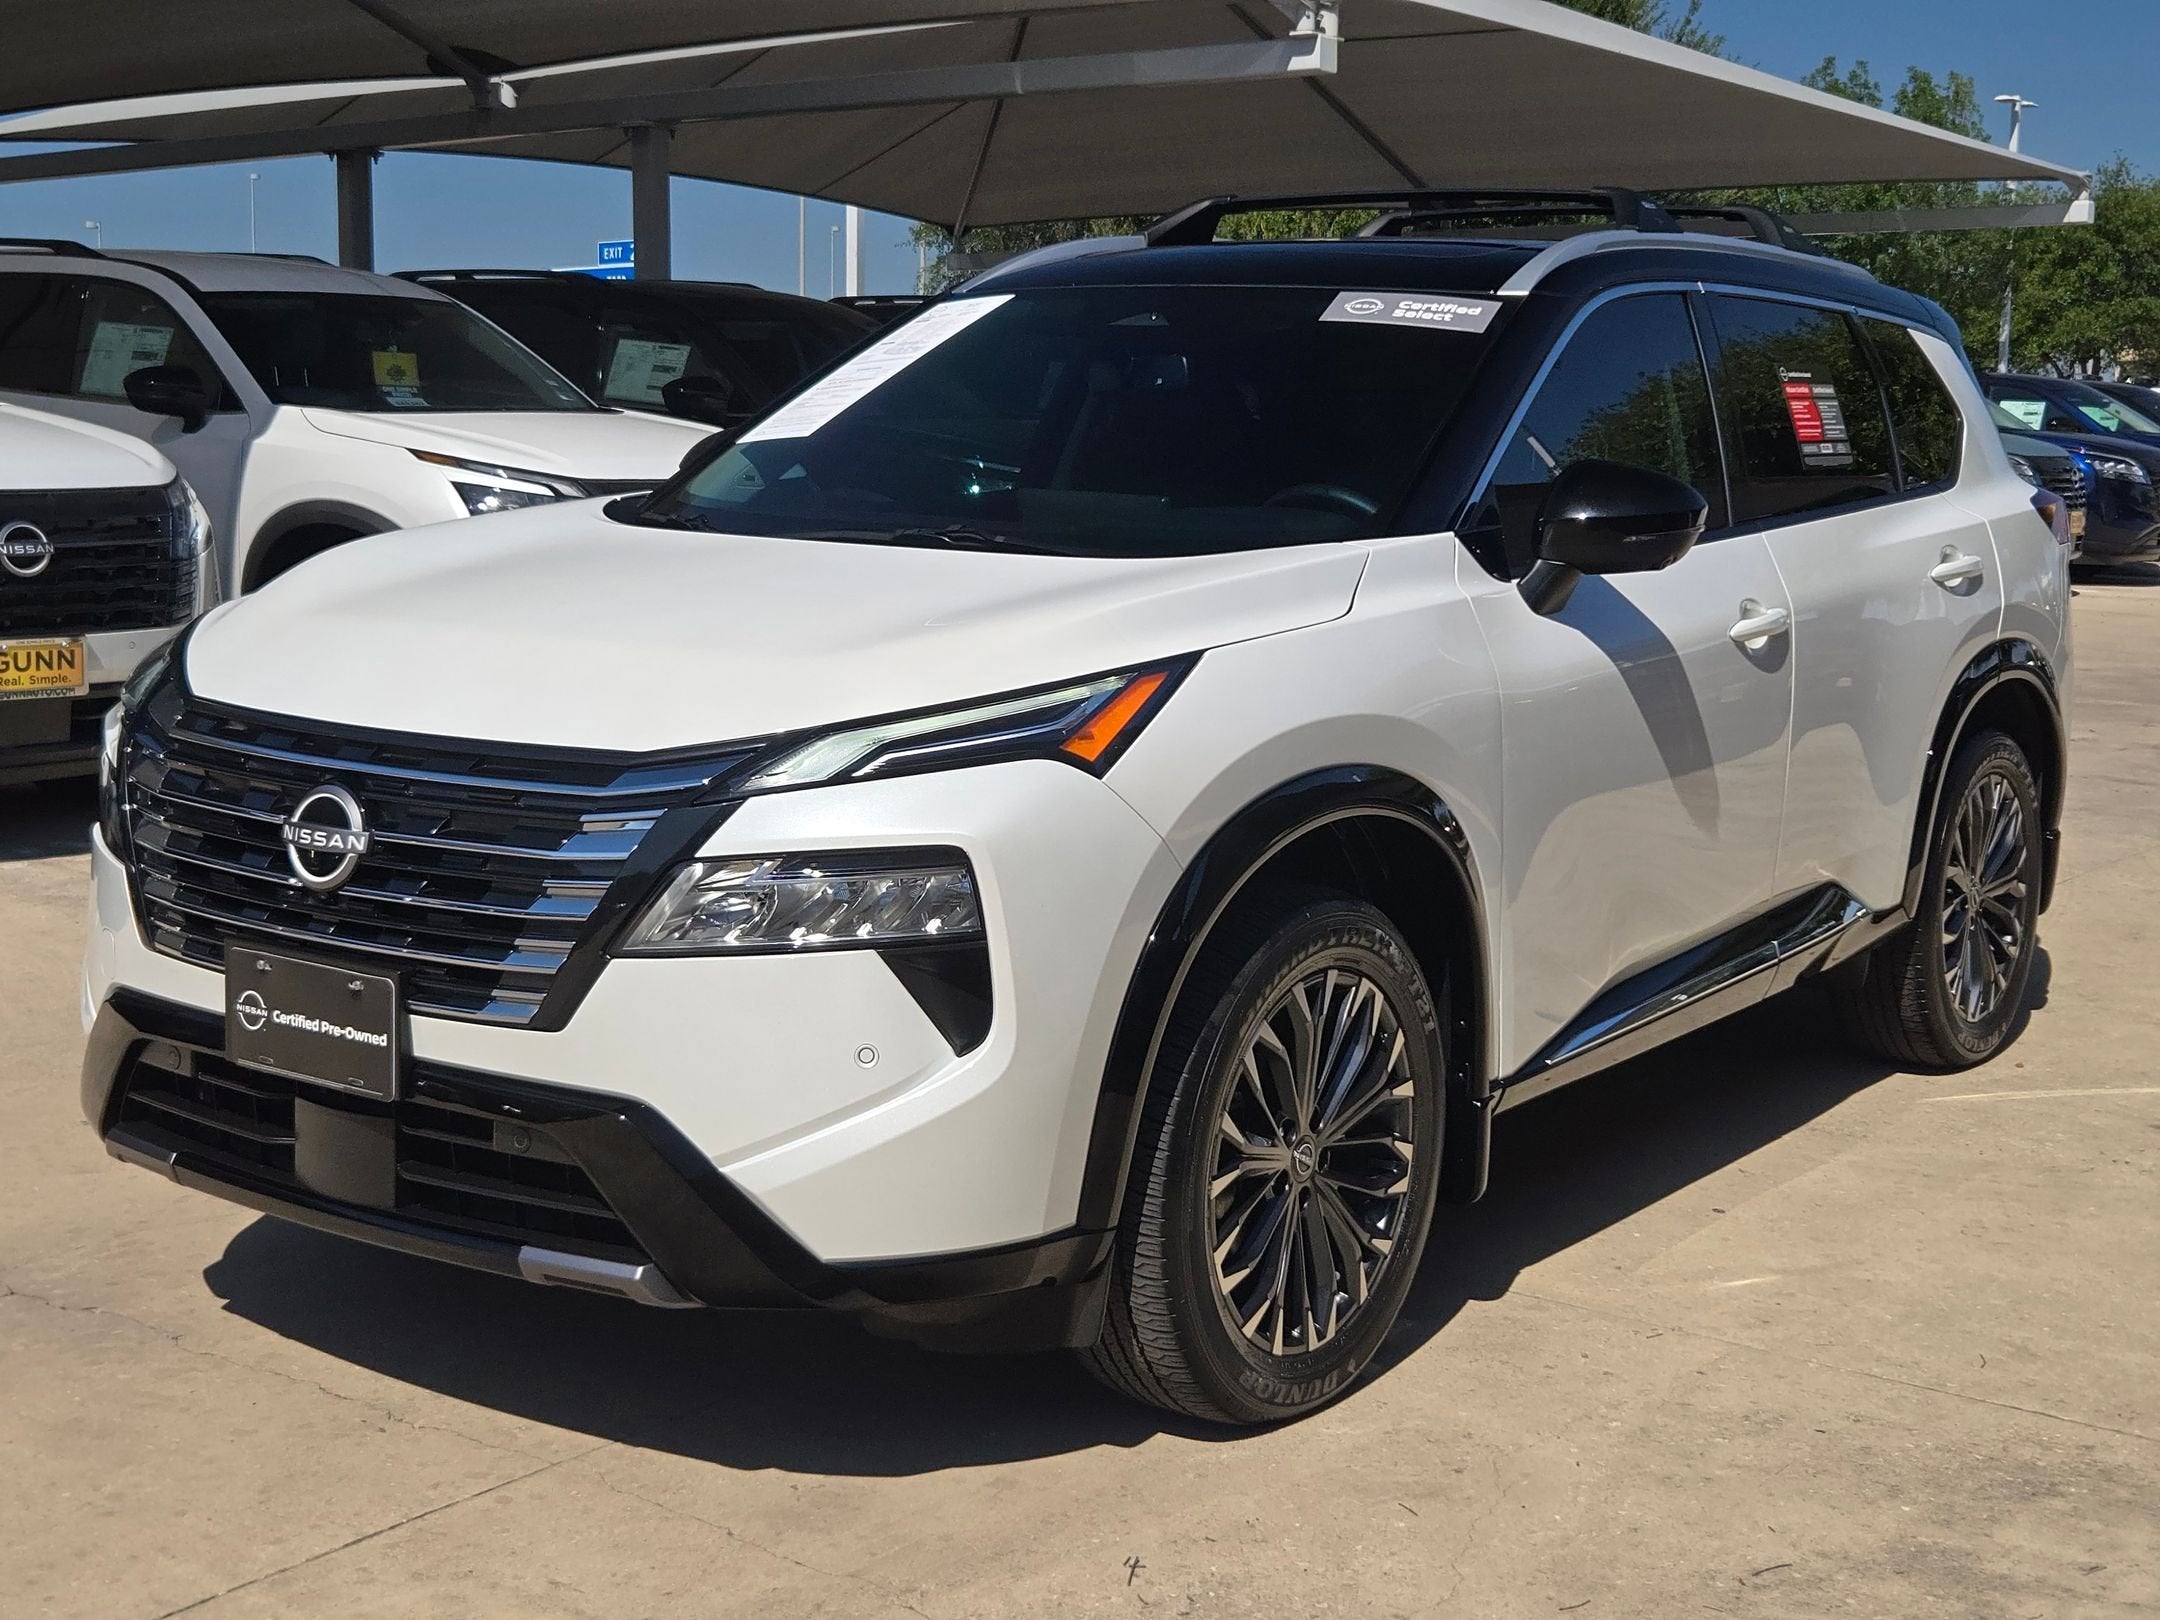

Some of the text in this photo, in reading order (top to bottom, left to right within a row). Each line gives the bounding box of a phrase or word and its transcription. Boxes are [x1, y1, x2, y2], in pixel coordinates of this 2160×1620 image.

[604, 246, 623, 260] EXIT
[1392, 309, 1454, 322] Select
[1398, 301, 1482, 316] Certified
[0, 544, 54, 554] NISSAN
[29, 673, 72, 685] Simple.
[283, 824, 366, 851] NISSAN
[236, 1003, 268, 1017] NISSAN
[273, 1010, 388, 1047] Certified Pre-Owned
[1240, 1366, 1340, 1403] DUNLOP
